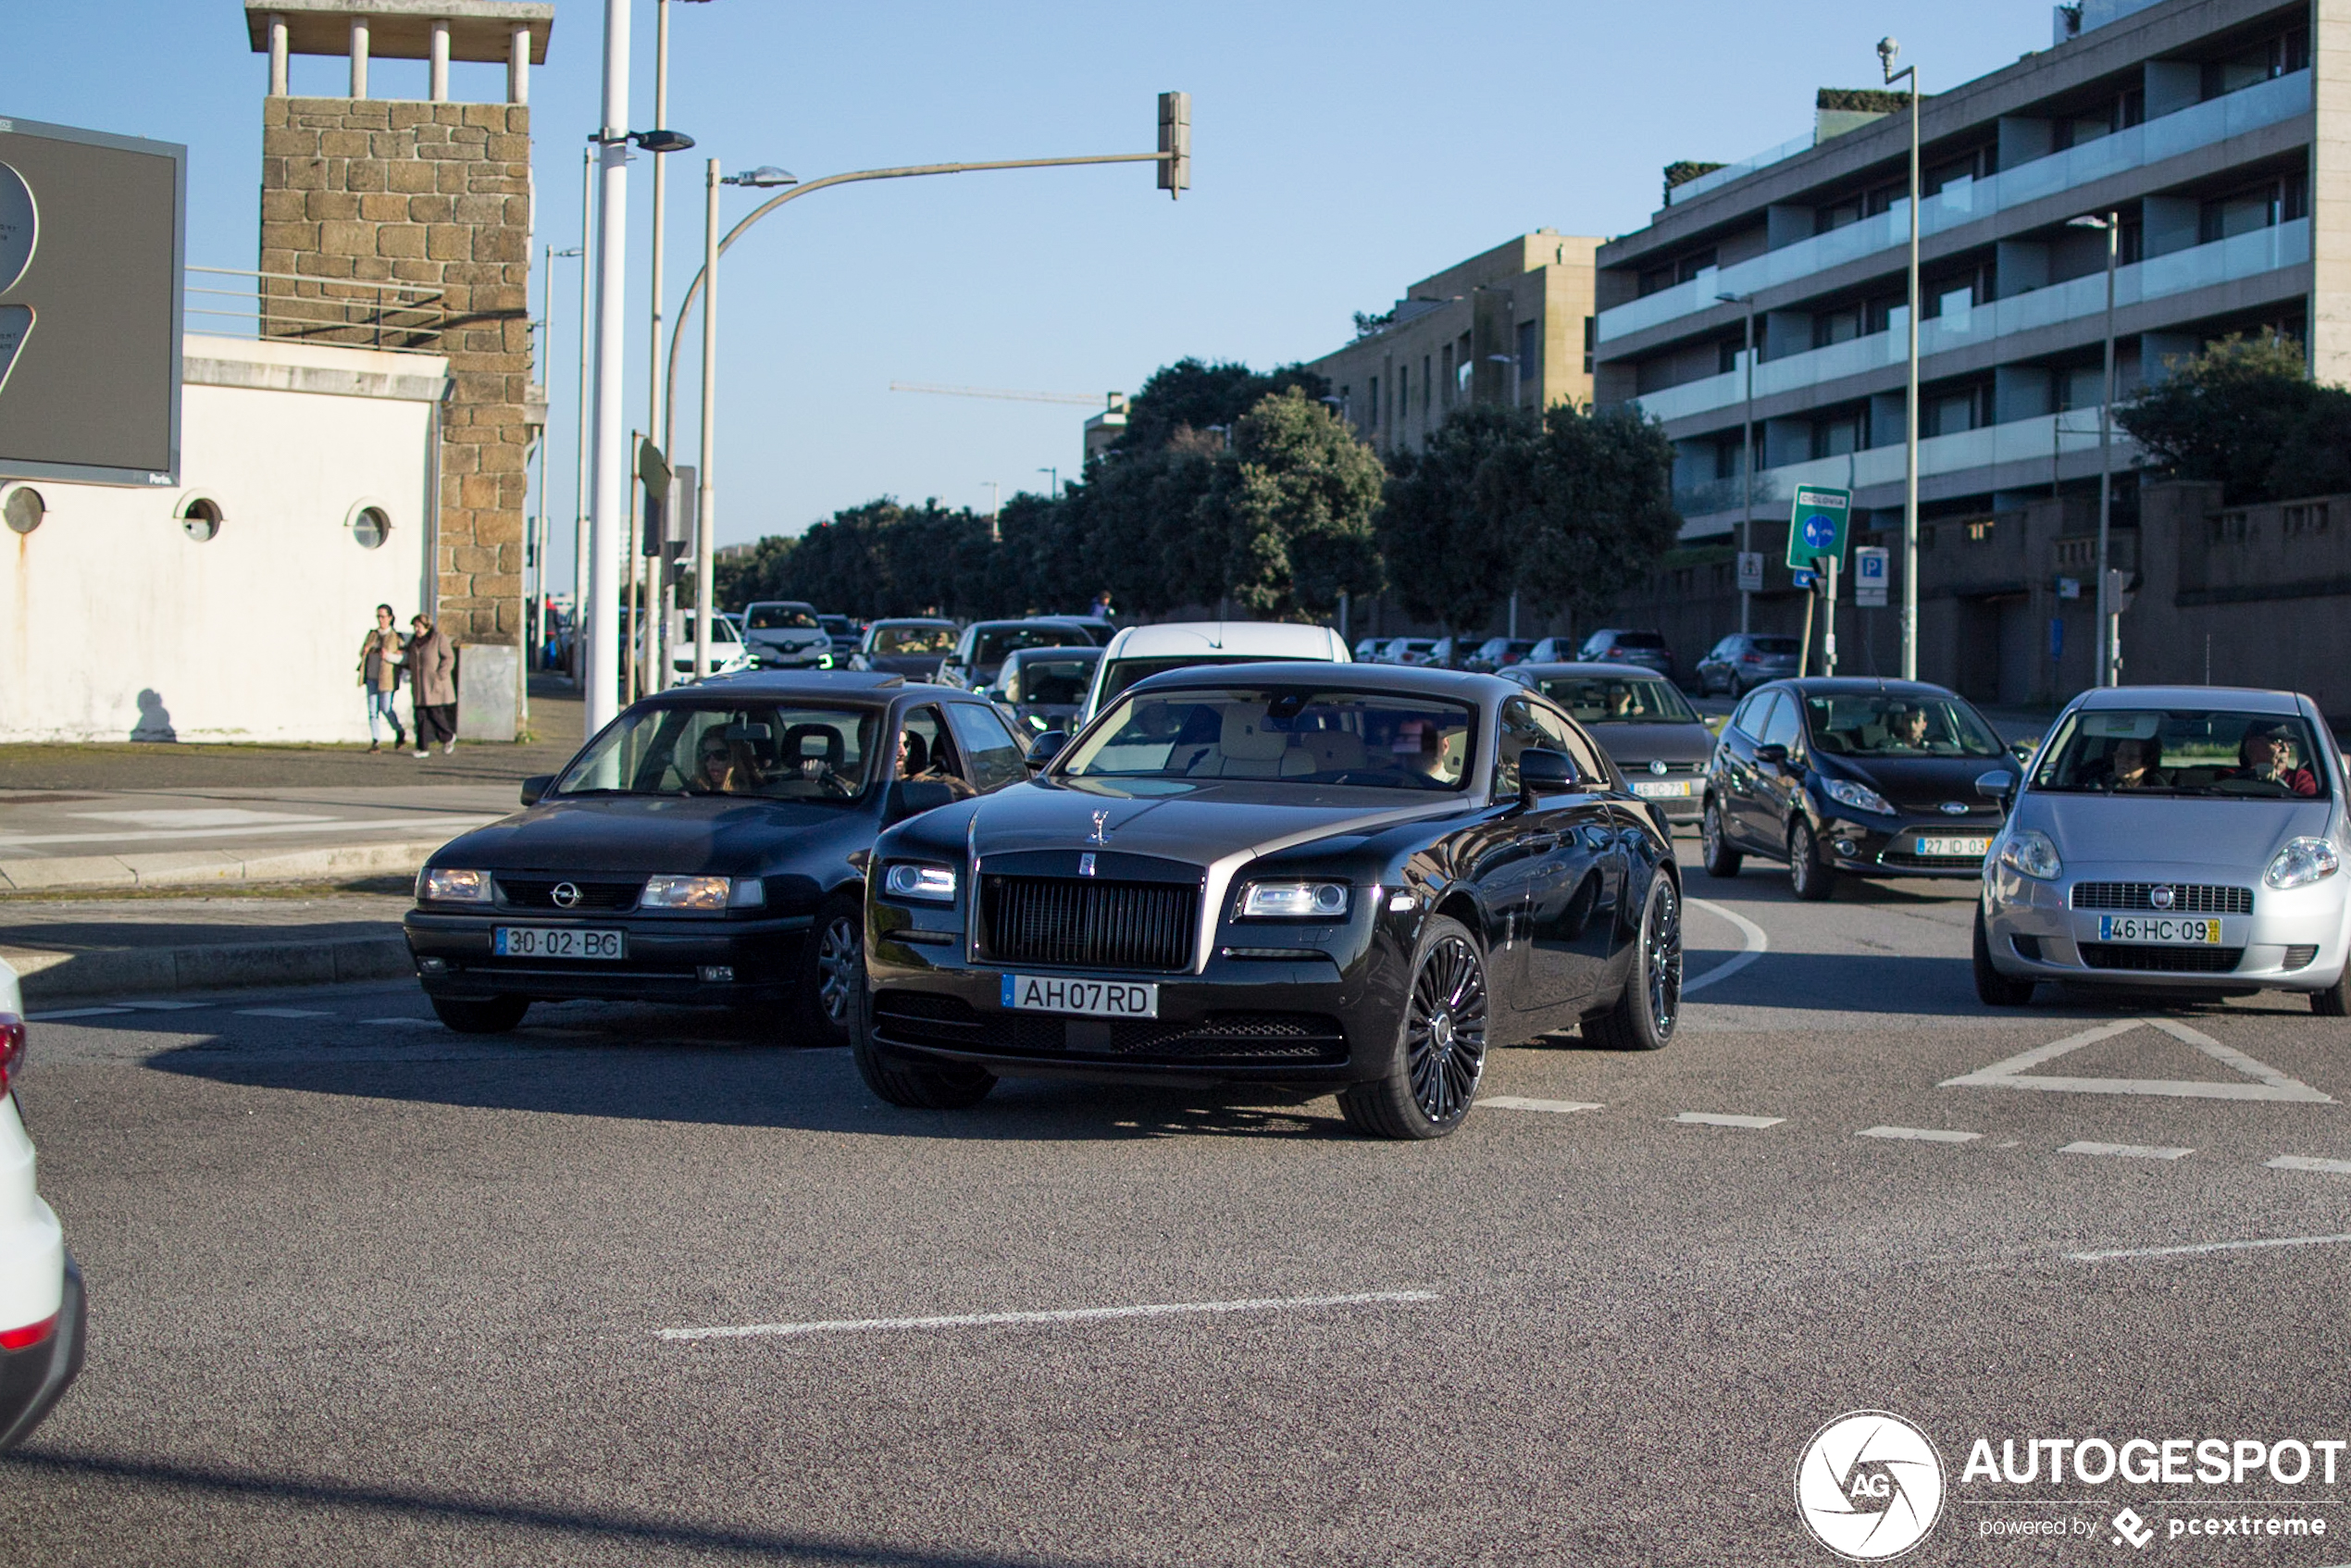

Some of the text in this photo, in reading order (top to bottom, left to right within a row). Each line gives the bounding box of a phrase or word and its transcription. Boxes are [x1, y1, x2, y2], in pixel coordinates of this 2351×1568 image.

[1801, 494, 1844, 507] CICLOVIA
[1867, 560, 1879, 575] P
[1024, 979, 1148, 1014] AH07RD
